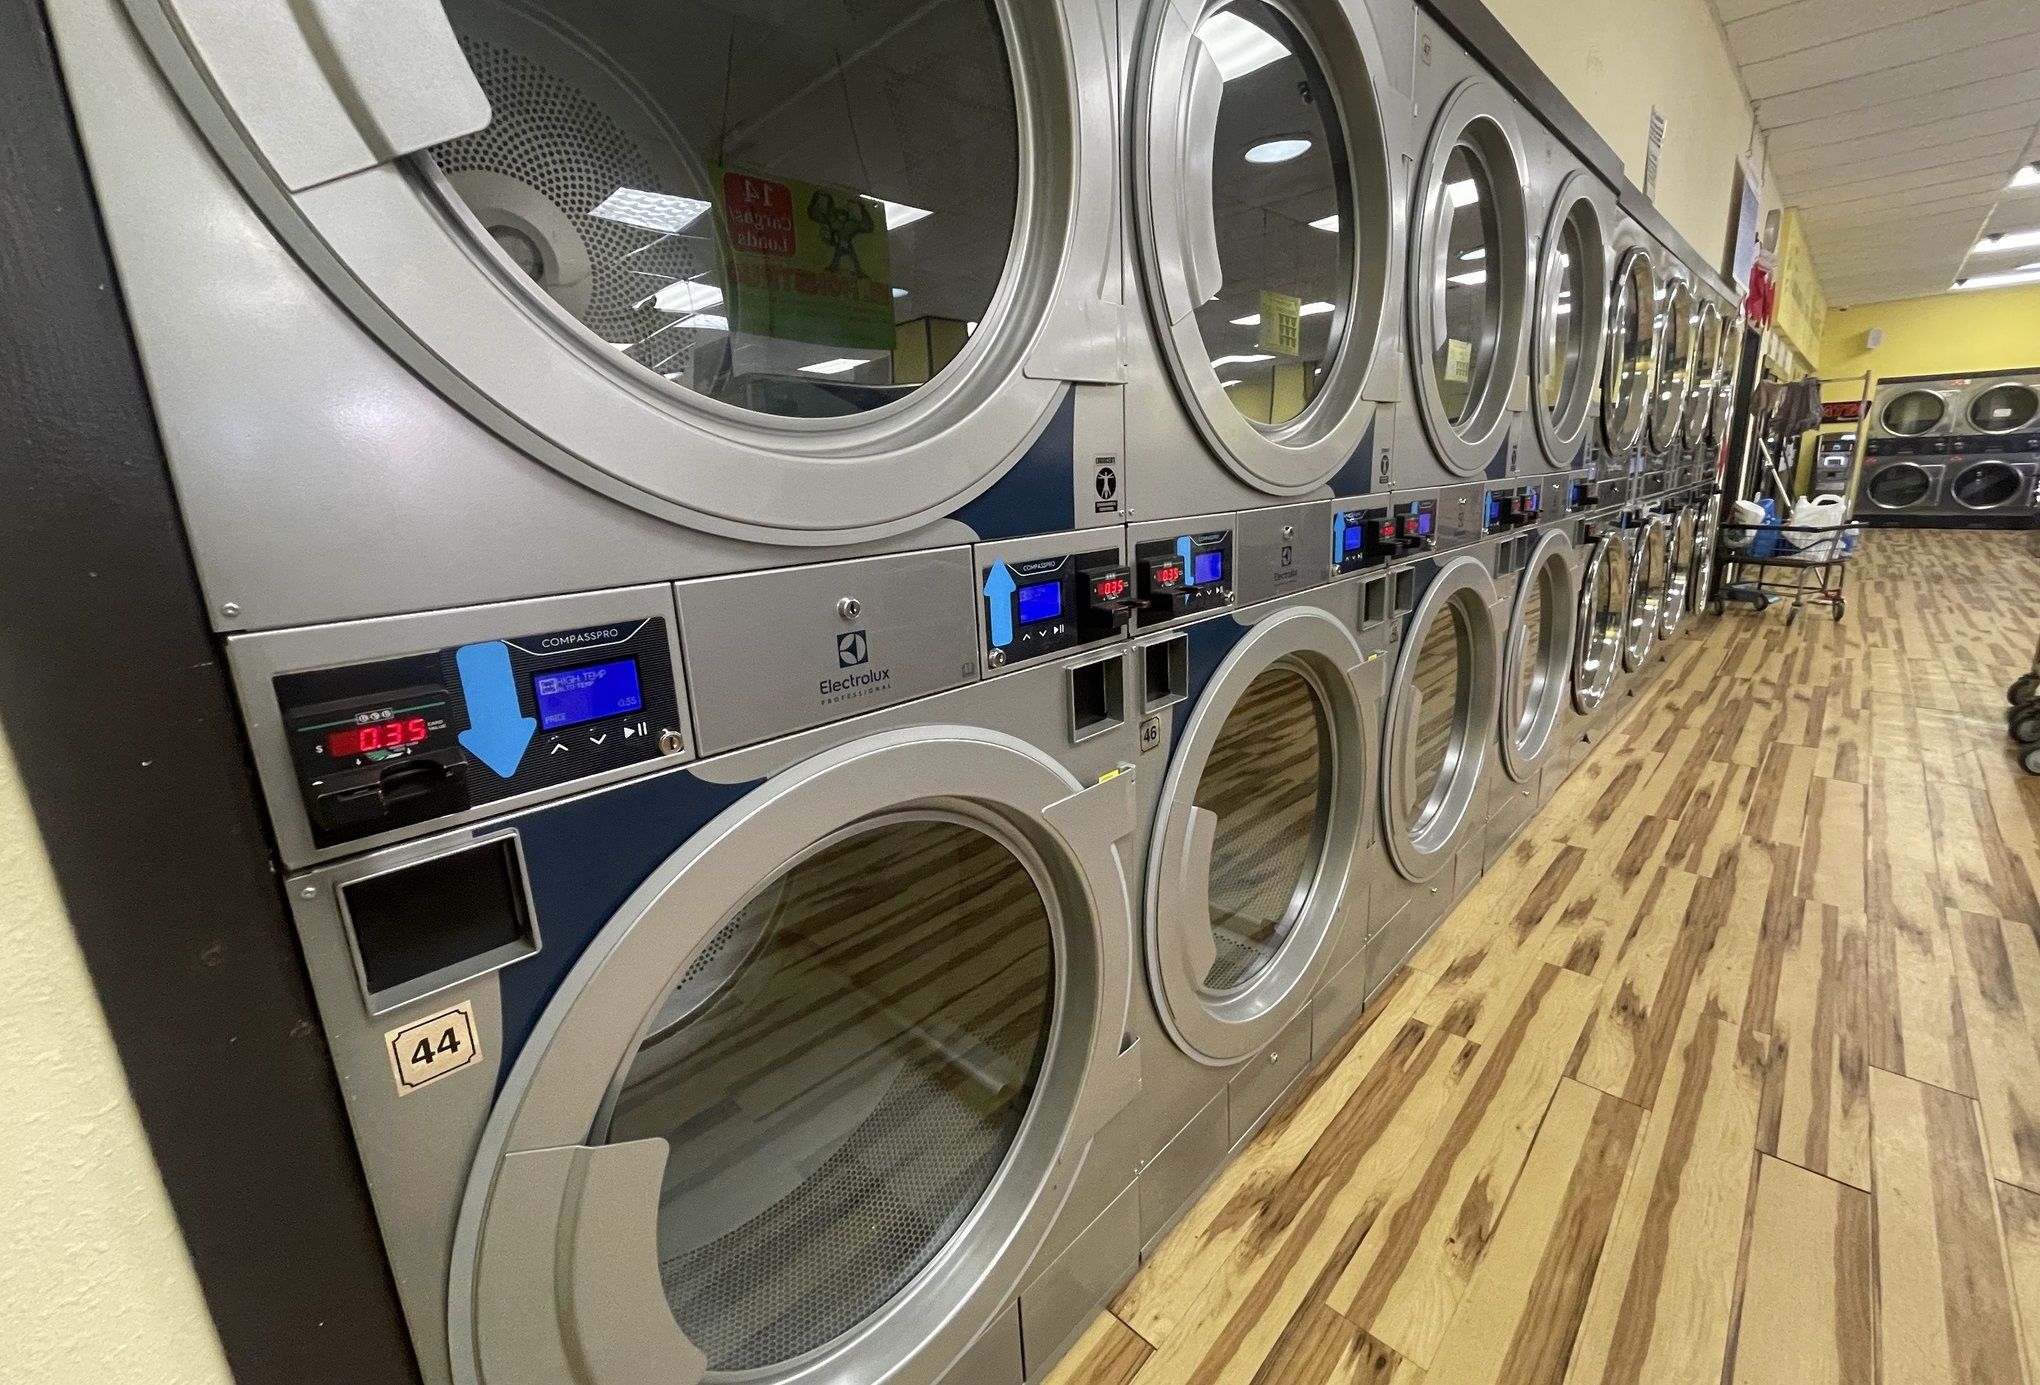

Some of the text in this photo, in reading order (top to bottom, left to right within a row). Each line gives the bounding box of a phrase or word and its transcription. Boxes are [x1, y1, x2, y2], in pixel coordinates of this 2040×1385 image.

[1023, 561, 1056, 571] COMPASSPRO
[541, 628, 619, 648] COMPASSPRO
[819, 669, 890, 695] Electrolux
[821, 684, 892, 706] PROFESSIONAL
[359, 718, 428, 752] 0.35
[1143, 725, 1157, 743] 46
[411, 1027, 461, 1064] 44
